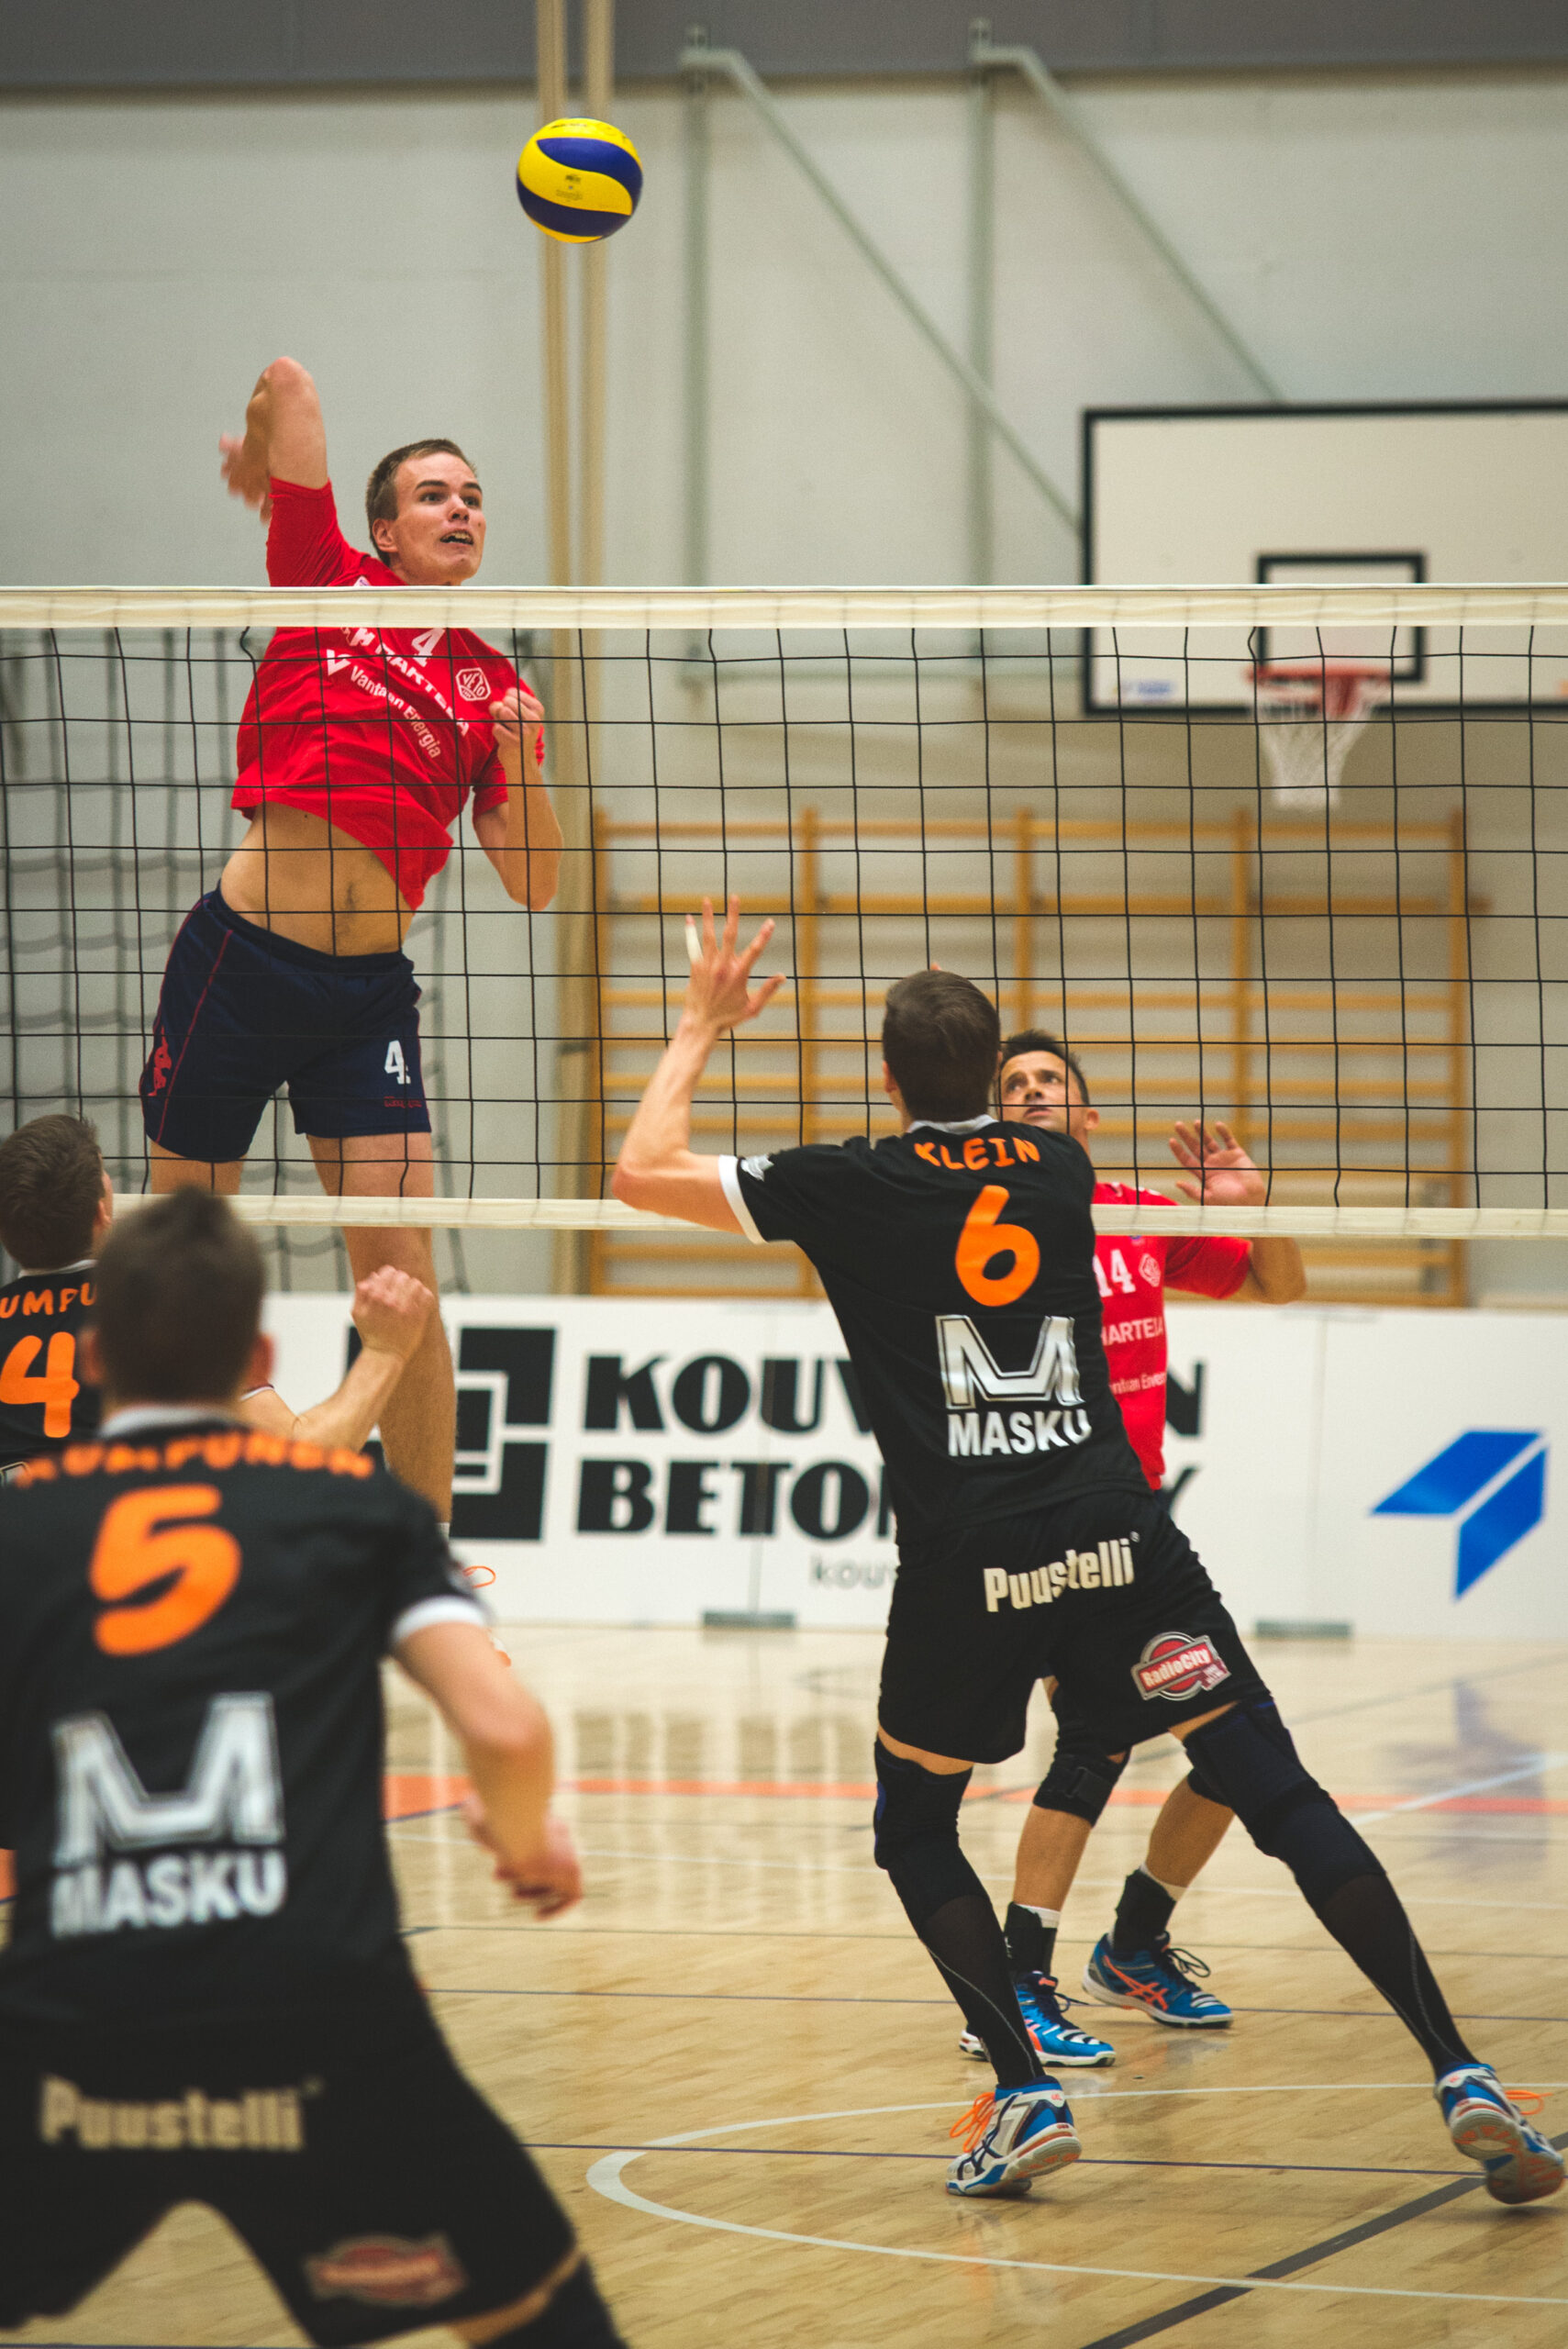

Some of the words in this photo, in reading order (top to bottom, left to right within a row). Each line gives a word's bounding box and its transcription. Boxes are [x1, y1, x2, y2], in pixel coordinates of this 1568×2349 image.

[411, 628, 446, 668] 4
[350, 664, 406, 710] Vantaan
[403, 705, 442, 760] Energia
[384, 1039, 412, 1085] 4
[915, 1136, 1040, 1172] KLEIN
[955, 1184, 1040, 1307] 6
[1092, 1249, 1137, 1298] 14
[0, 1330, 81, 1439] 4
[947, 1409, 1093, 1457] MASKU
[90, 1483, 242, 1657] 5
[983, 1537, 1135, 1613] Puustelli
[1140, 1648, 1212, 1688] RadioCity
[50, 1850, 288, 1939] MASKU
[39, 2074, 306, 2152] Puustelli
